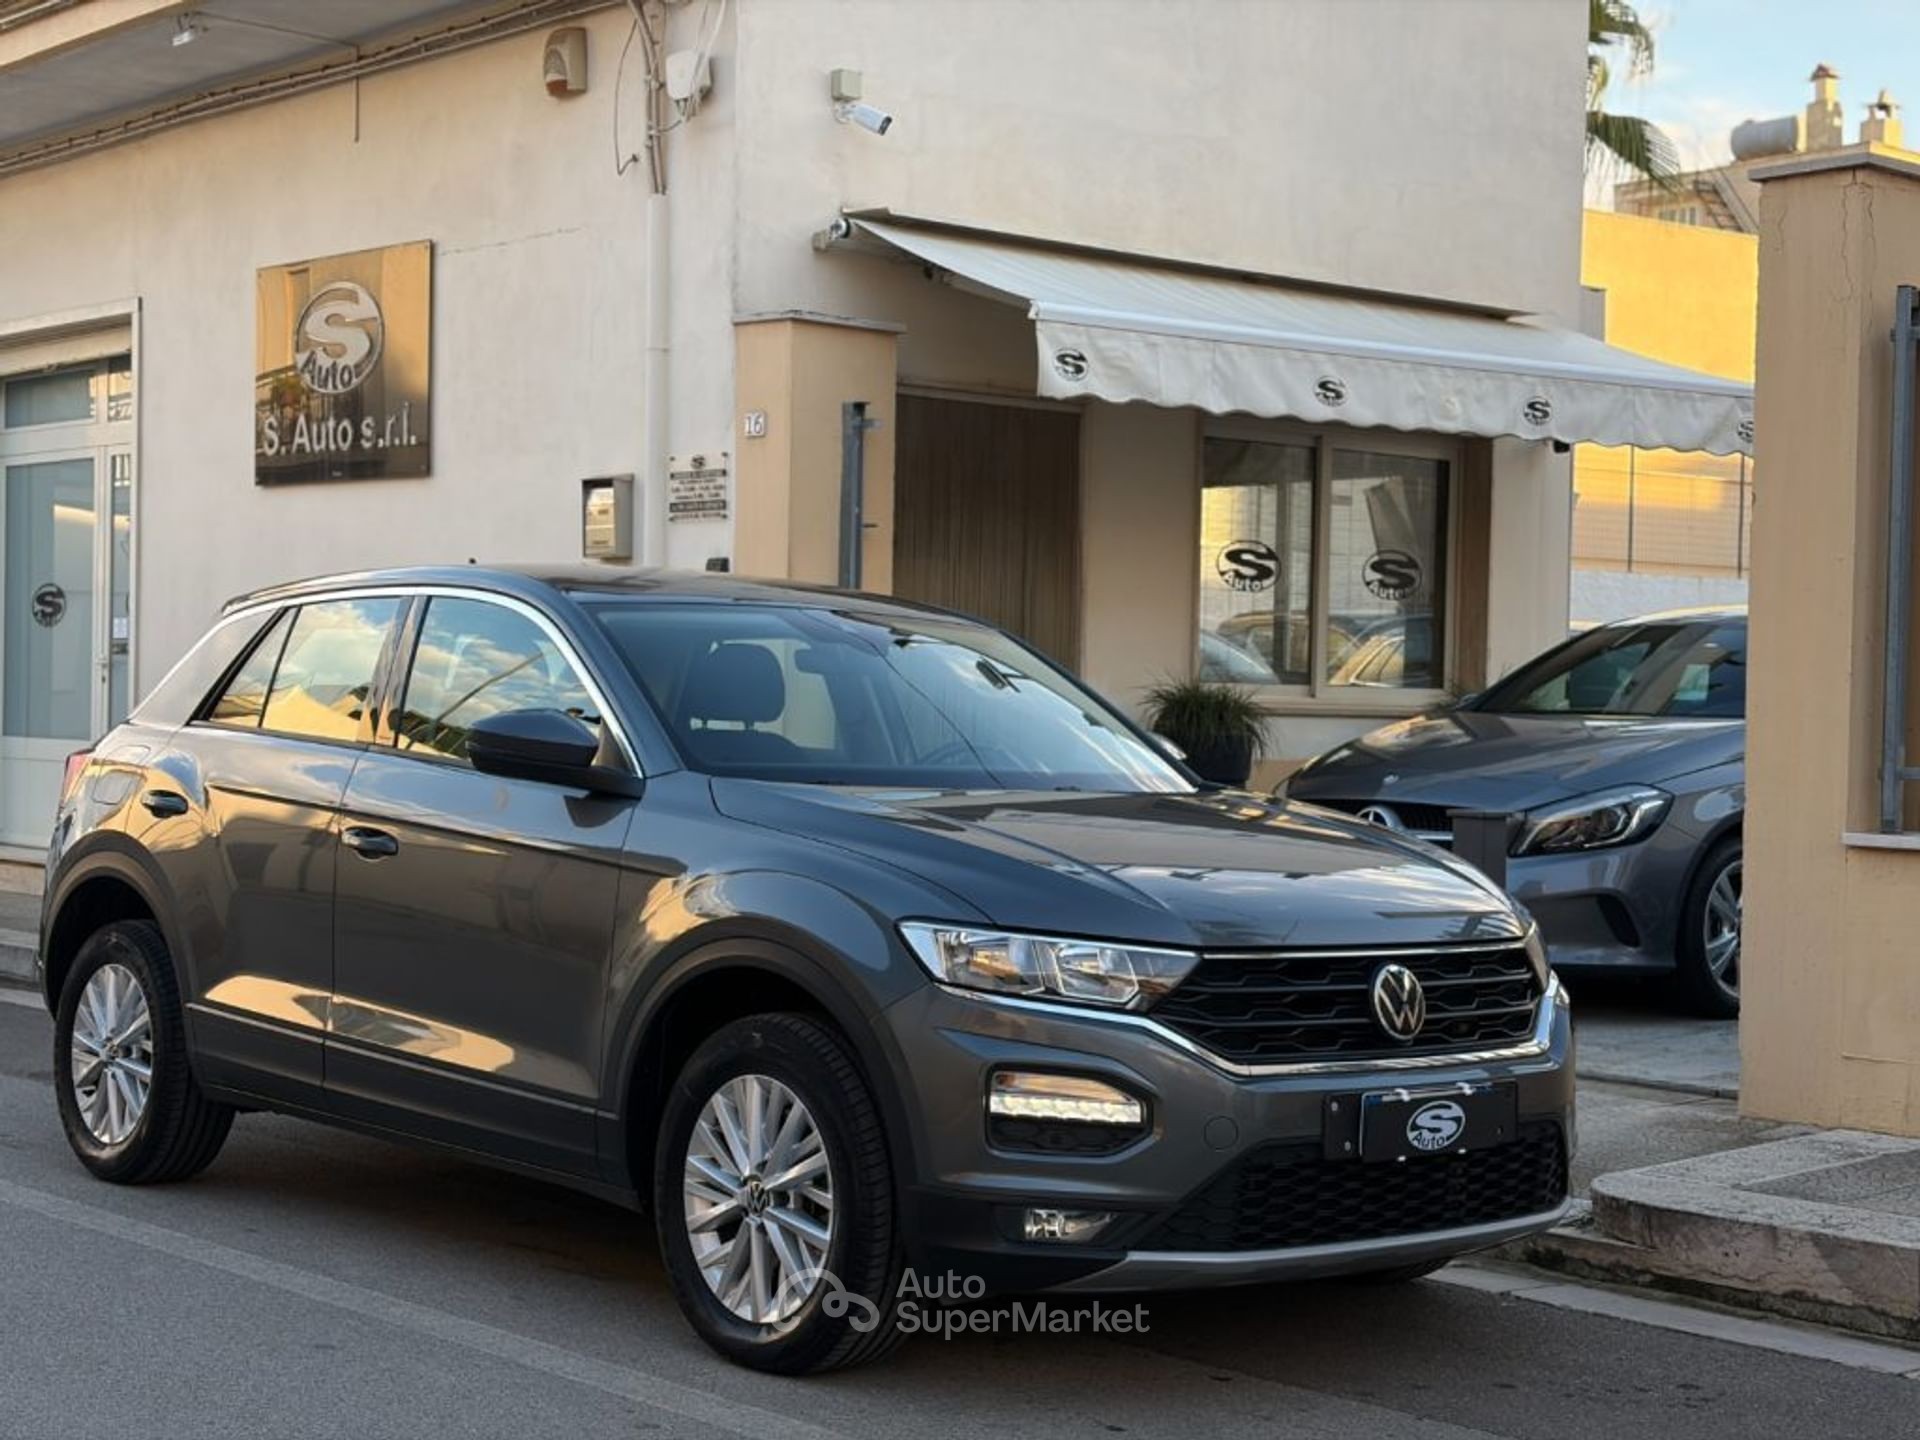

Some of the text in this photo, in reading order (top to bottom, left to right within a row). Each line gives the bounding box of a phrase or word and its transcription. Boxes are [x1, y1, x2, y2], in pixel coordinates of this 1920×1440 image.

[301, 353, 352, 391] Auto
[264, 401, 416, 456] S. Auto s.r.l.
[746, 414, 763, 435] 16
[1224, 571, 1263, 592] Auto
[1368, 581, 1402, 600] Auto
[1412, 1132, 1446, 1149] Auto
